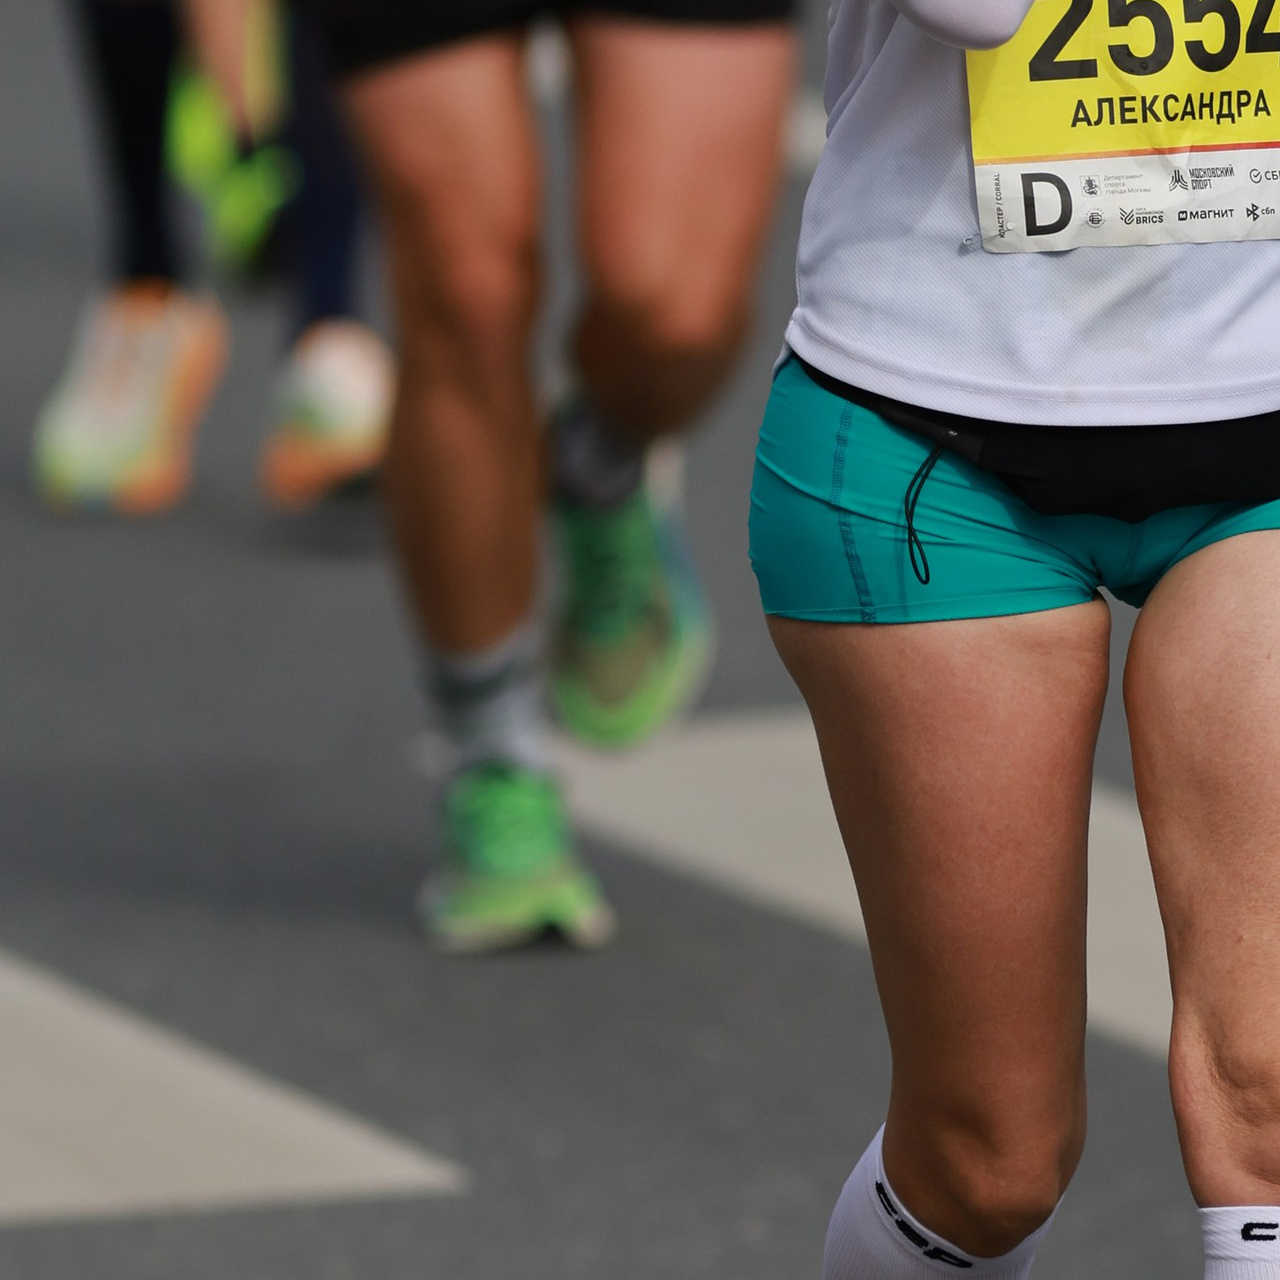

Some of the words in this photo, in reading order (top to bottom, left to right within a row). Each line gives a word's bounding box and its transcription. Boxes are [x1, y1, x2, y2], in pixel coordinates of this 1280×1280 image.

[1070, 88, 1272, 128] АЛЕКСАНДРА
[1103, 173, 1144, 181] Департамент
[1189, 164, 1235, 179] МОСКОВСКИЙ
[1191, 179, 1213, 190] СПОРТ
[1020, 172, 1073, 236] D
[1189, 209, 1234, 220] магнит
[1261, 207, 1276, 215] сбп
[1135, 215, 1164, 225] BRICS
